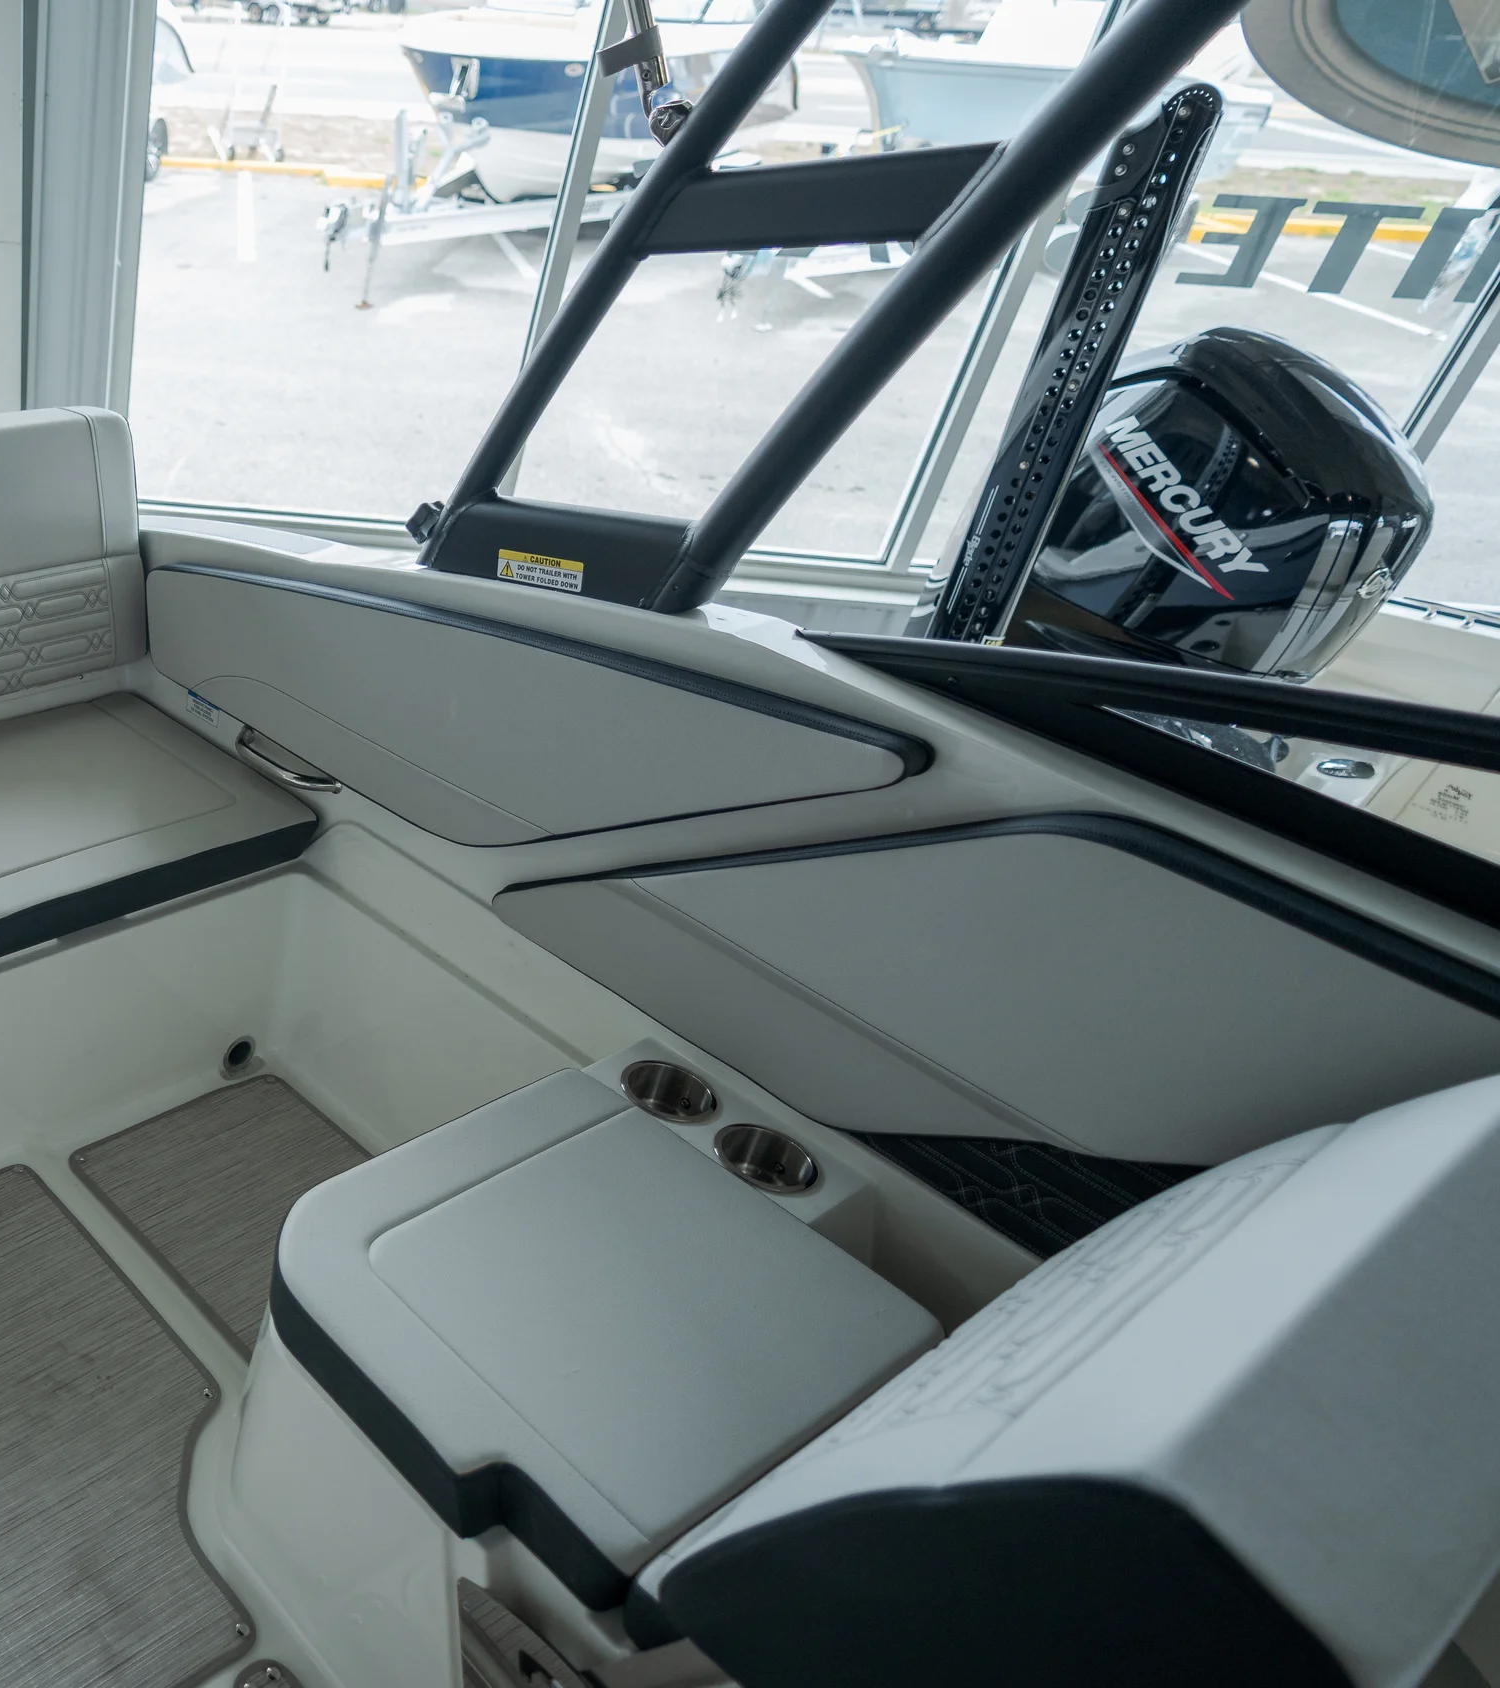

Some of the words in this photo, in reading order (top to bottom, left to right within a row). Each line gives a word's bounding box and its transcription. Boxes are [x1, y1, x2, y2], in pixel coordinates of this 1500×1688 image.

[1105, 415, 1270, 573] MERCURY
[964, 535, 981, 567] Blade
[530, 555, 561, 568] CAUTION
[515, 572, 535, 582] TOWER
[536, 576, 559, 587] FOLDED
[560, 581, 578, 590] DOWN
[526, 565, 537, 573] NOT
[539, 568, 561, 577] TRAILER
[562, 571, 577, 580] WITH
